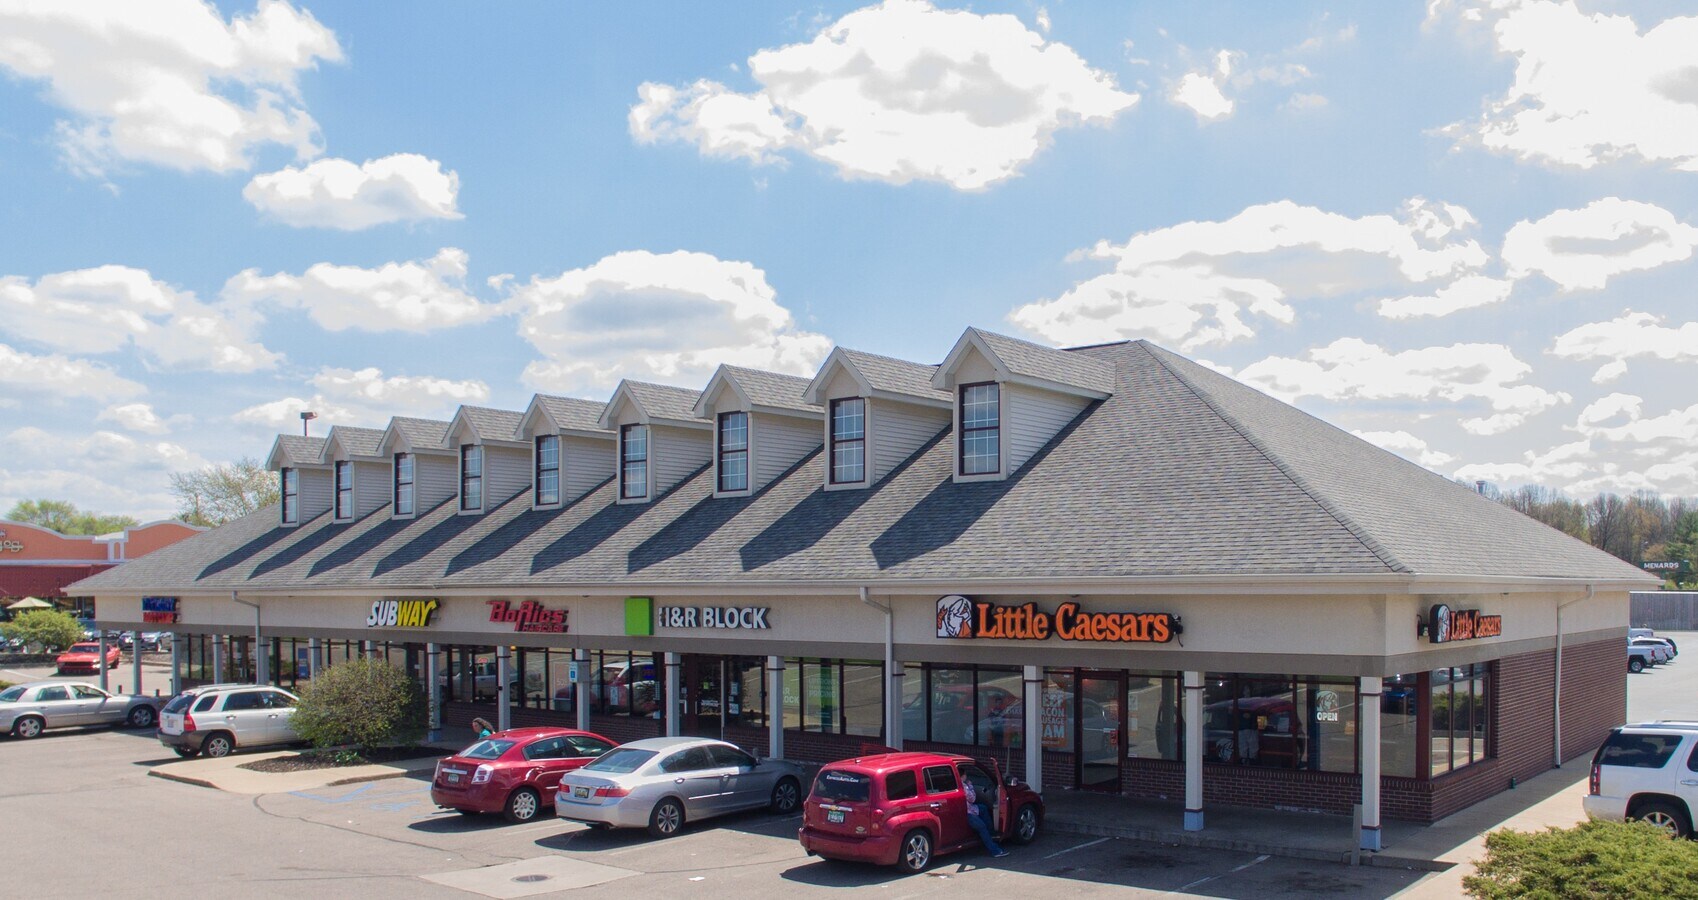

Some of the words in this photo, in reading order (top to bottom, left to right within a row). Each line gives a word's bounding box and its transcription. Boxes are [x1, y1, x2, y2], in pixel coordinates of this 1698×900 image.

[366, 599, 438, 626] SUBWAY
[703, 606, 770, 629] BLOCK
[976, 602, 1049, 640] Little
[1055, 602, 1170, 643] Caesars
[1450, 611, 1473, 640] Little
[783, 695, 799, 704] OCK
[1316, 711, 1339, 721] OPEN
